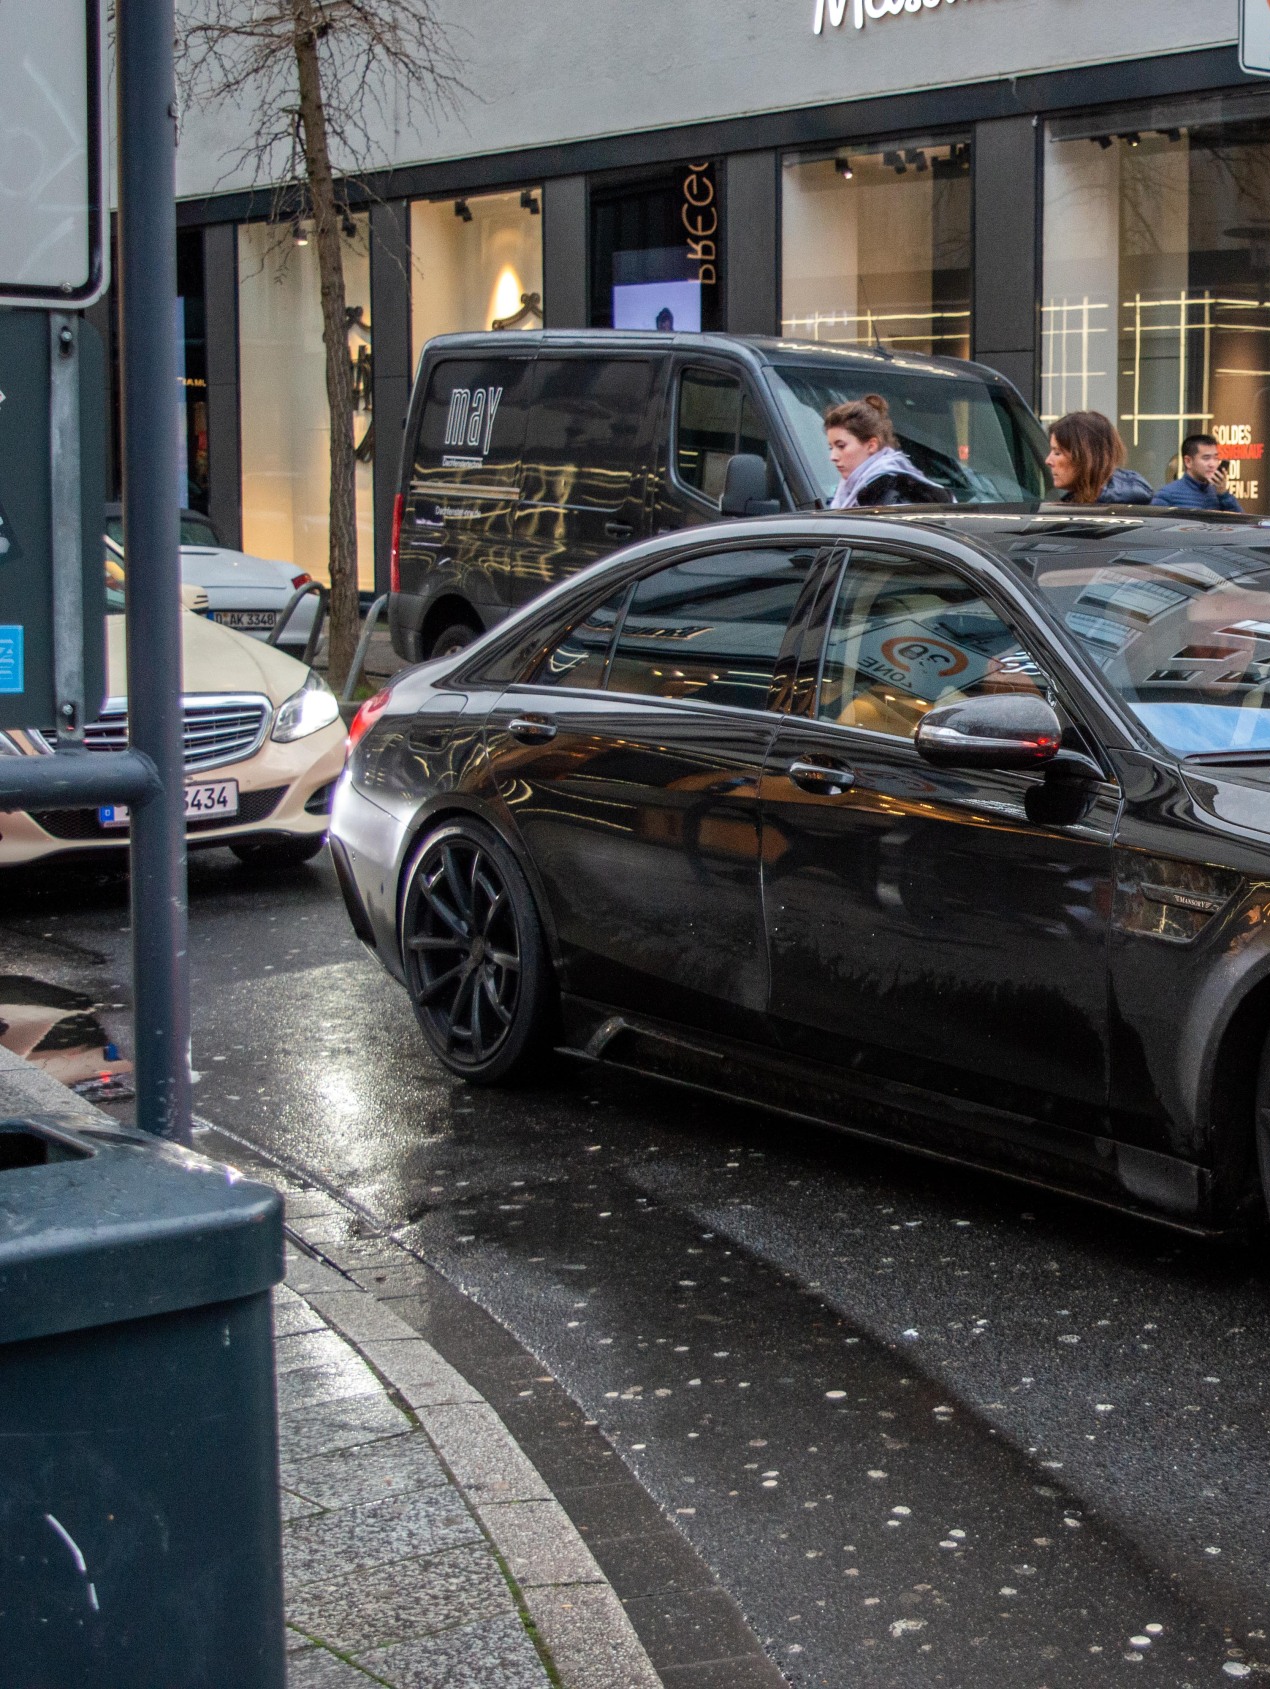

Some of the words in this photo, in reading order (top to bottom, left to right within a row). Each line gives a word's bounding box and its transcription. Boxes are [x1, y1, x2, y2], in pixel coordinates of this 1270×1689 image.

[444, 386, 503, 455] may
[1212, 424, 1252, 446] SOLDES
[230, 613, 244, 625] AK
[247, 612, 274, 625] 3348
